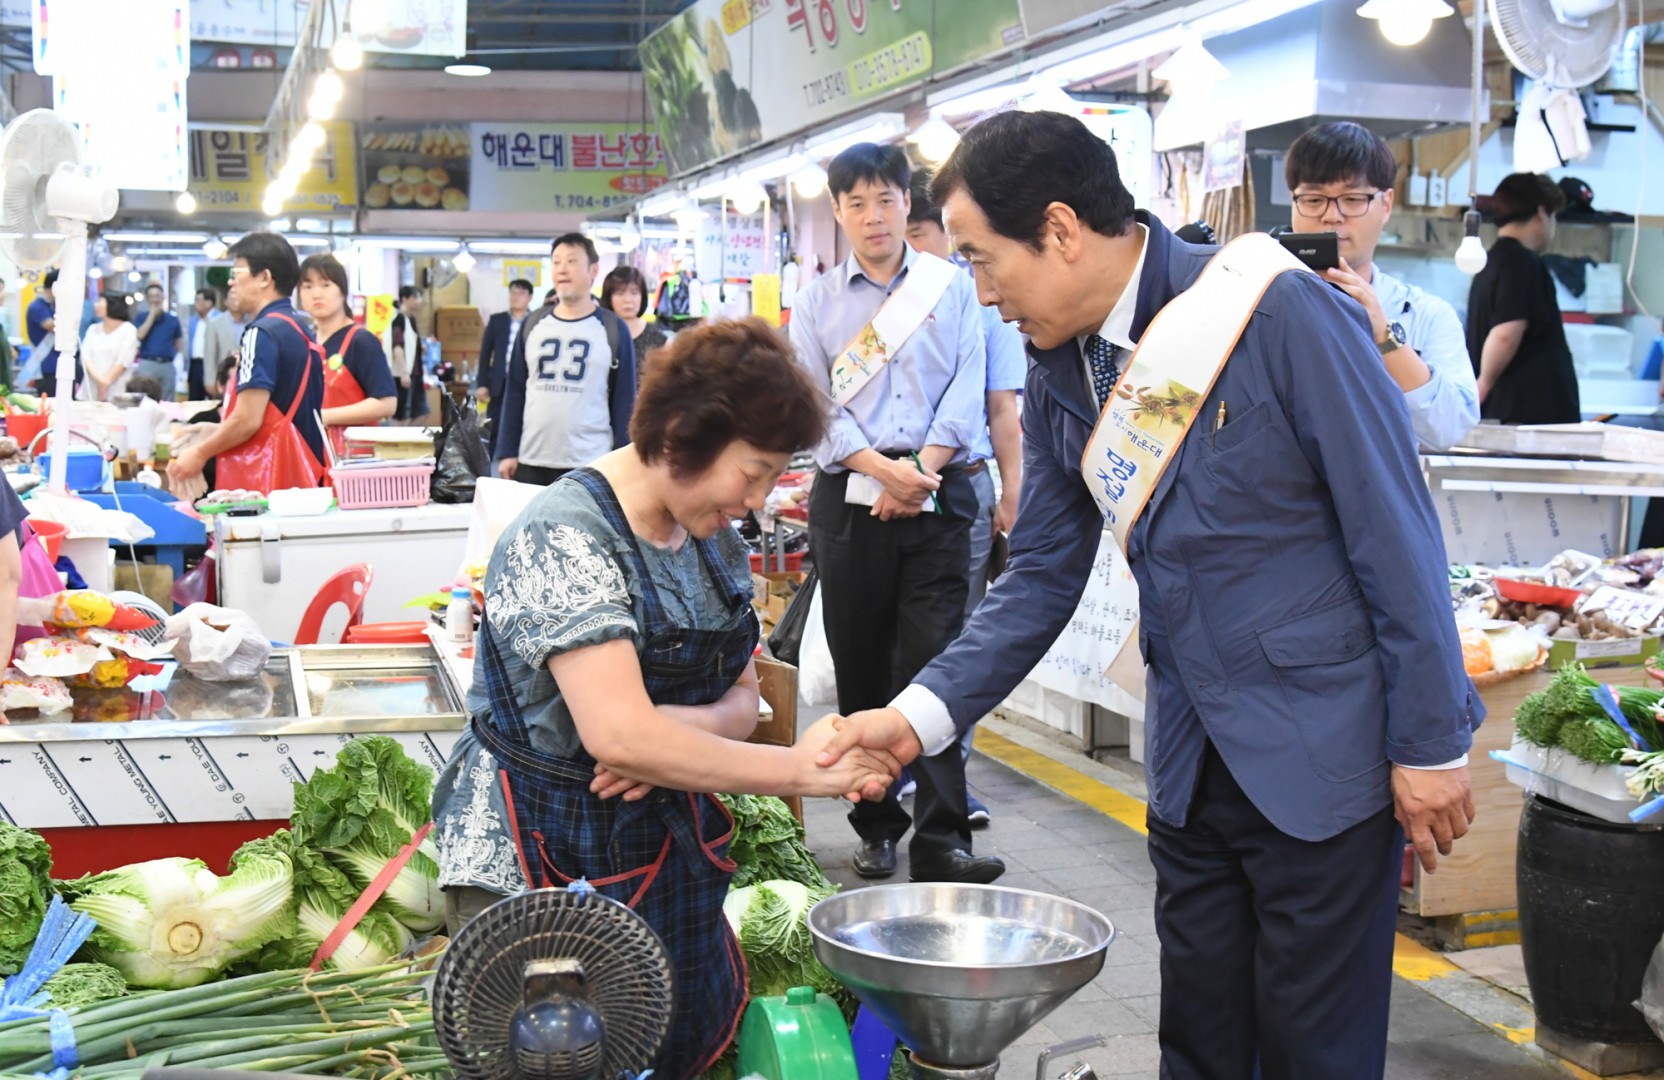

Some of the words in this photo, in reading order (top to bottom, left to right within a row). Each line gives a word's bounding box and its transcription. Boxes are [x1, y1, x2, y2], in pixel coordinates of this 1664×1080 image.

[481, 132, 565, 168] 해운대
[572, 132, 665, 168] 불난호
[538, 338, 590, 381] 23
[1127, 429, 1163, 459] 해운대
[32, 750, 68, 796] COMPANY
[113, 746, 137, 780] METAL
[201, 761, 221, 783] DAE
[418, 739, 443, 776] MPANY
[69, 796, 92, 826] METAL
[134, 779, 160, 811] YOUNG
